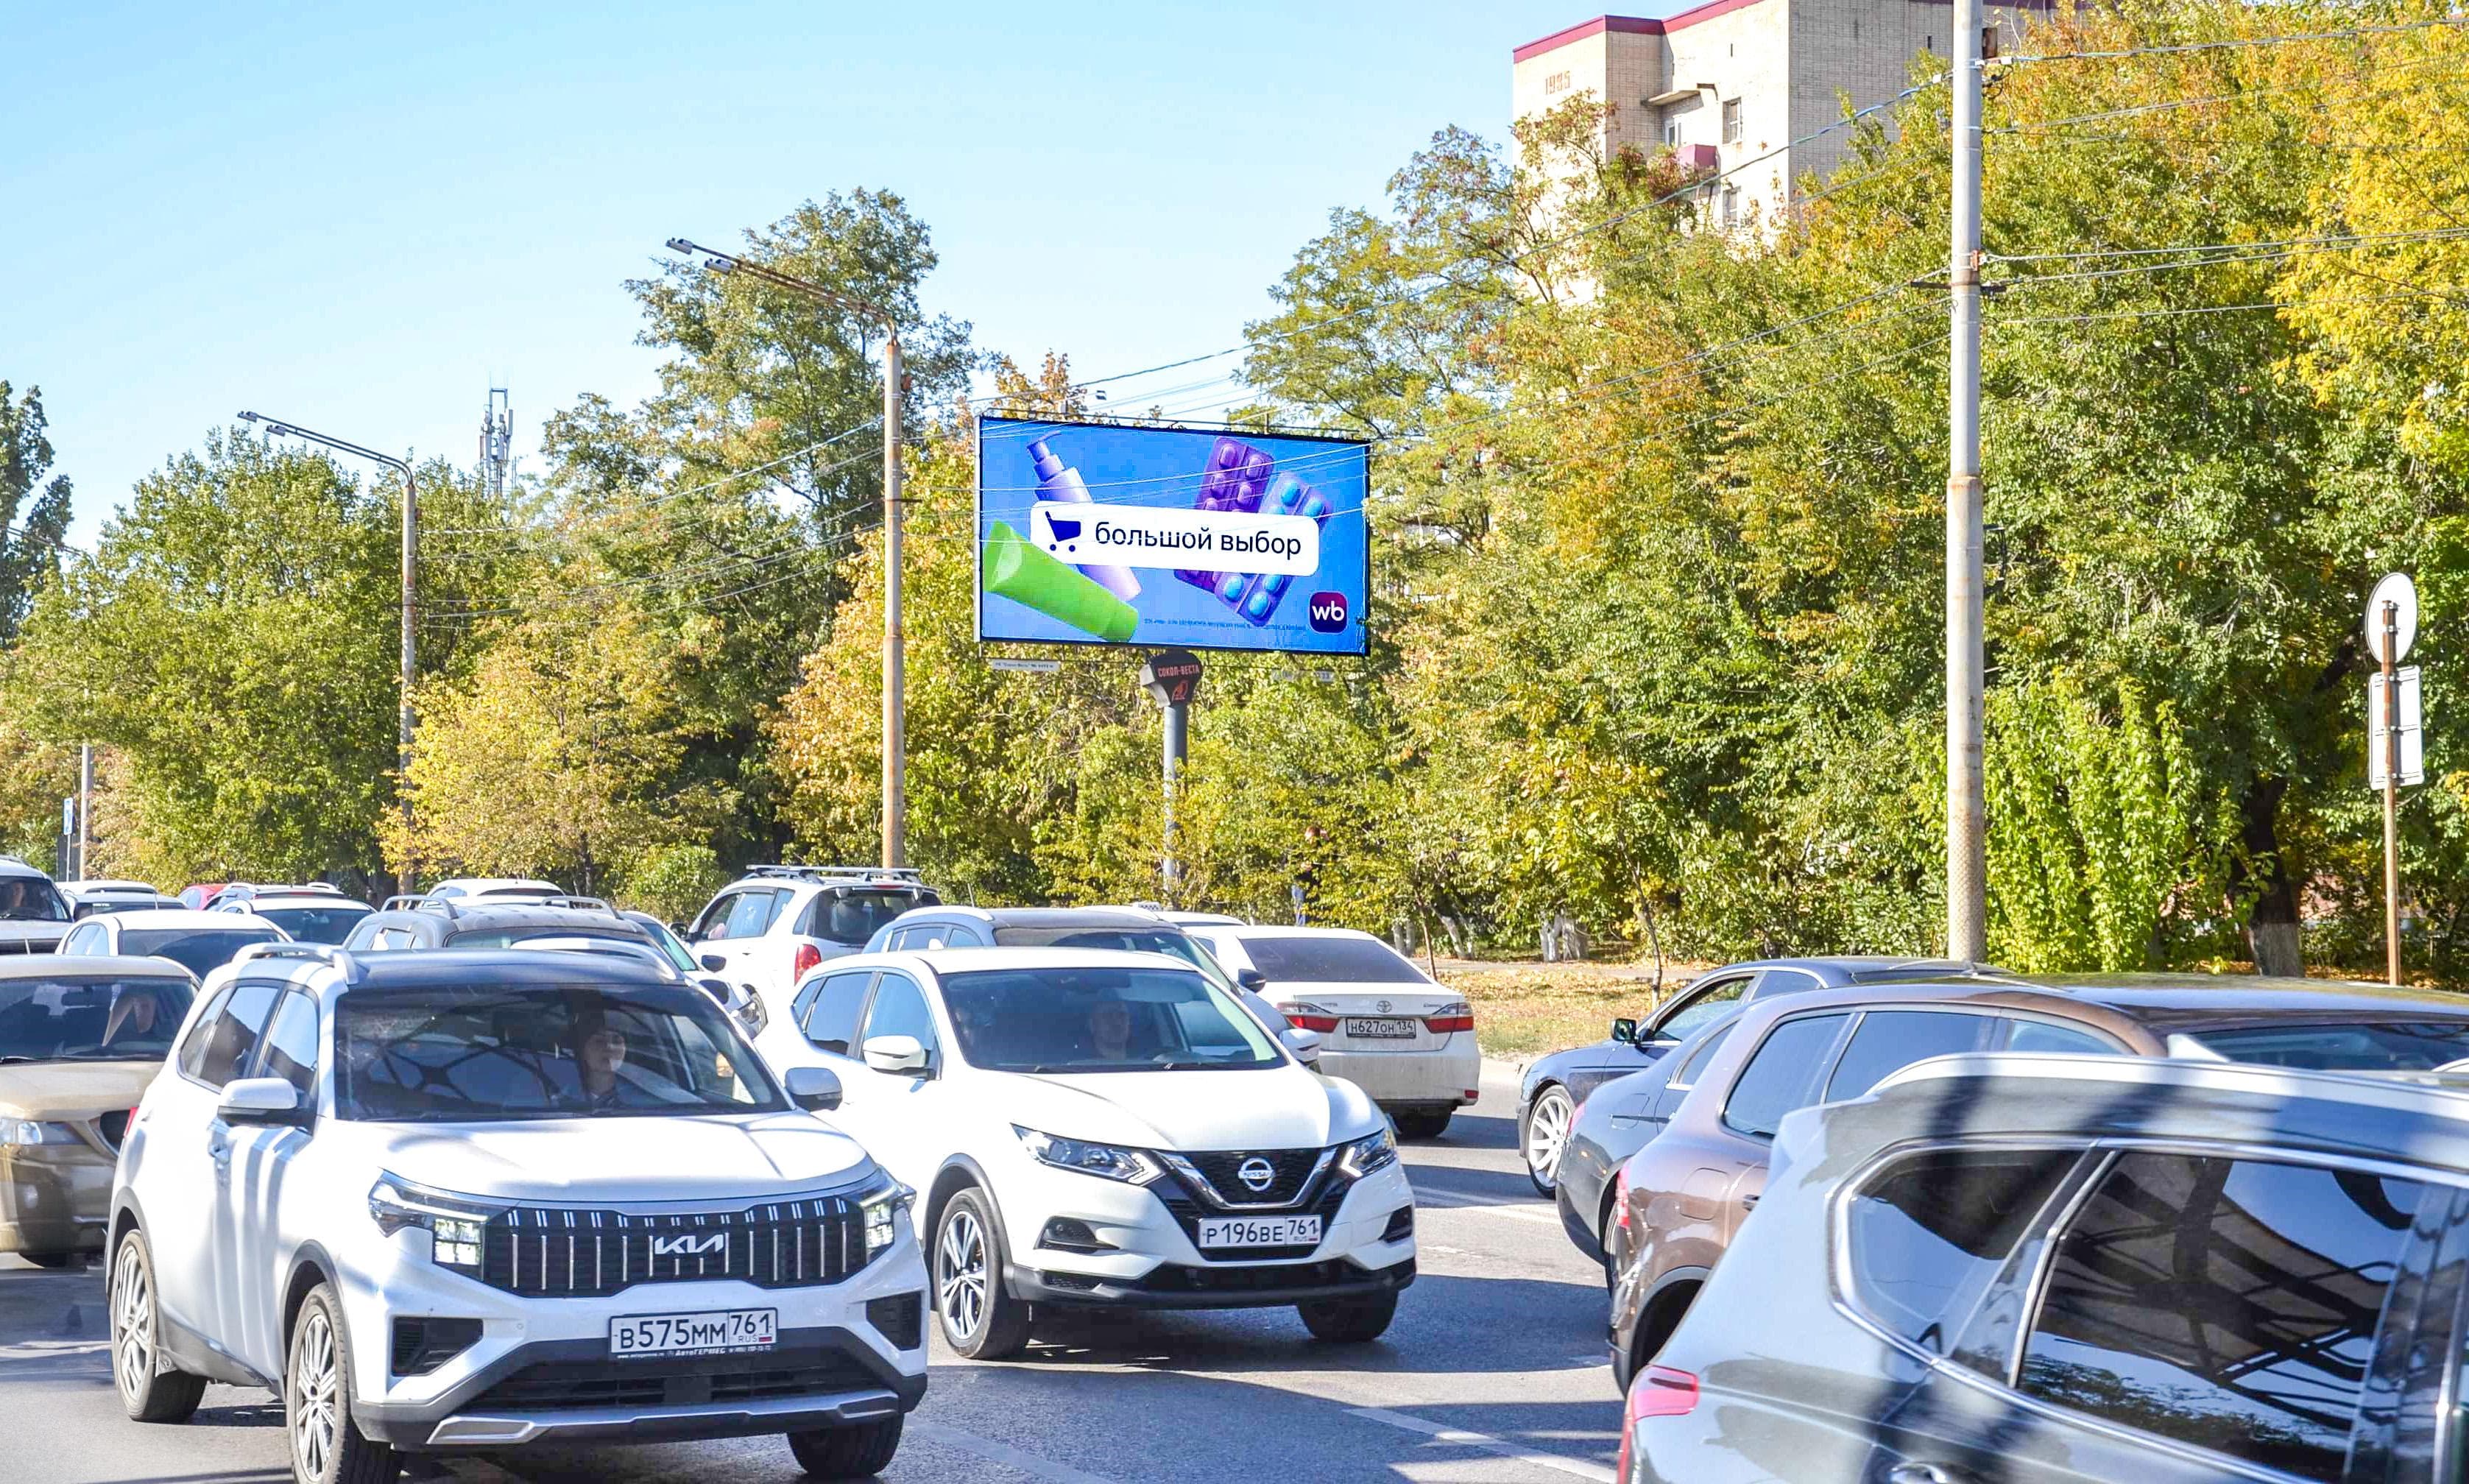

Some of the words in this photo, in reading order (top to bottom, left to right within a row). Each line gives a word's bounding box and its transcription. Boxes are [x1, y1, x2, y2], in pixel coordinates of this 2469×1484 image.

[1095, 521, 1212, 551] большой
[1221, 531, 1301, 560] выбор
[1312, 601, 1345, 621] wb
[1351, 1020, 1394, 1034] Н627ОН
[1397, 1020, 1413, 1031] 134
[1207, 1223, 1284, 1243] Р196ВЕ
[1288, 1219, 1317, 1235] 761
[621, 1319, 726, 1349] В575ММ
[730, 1313, 769, 1335] 761
[738, 1335, 757, 1343] RUS
